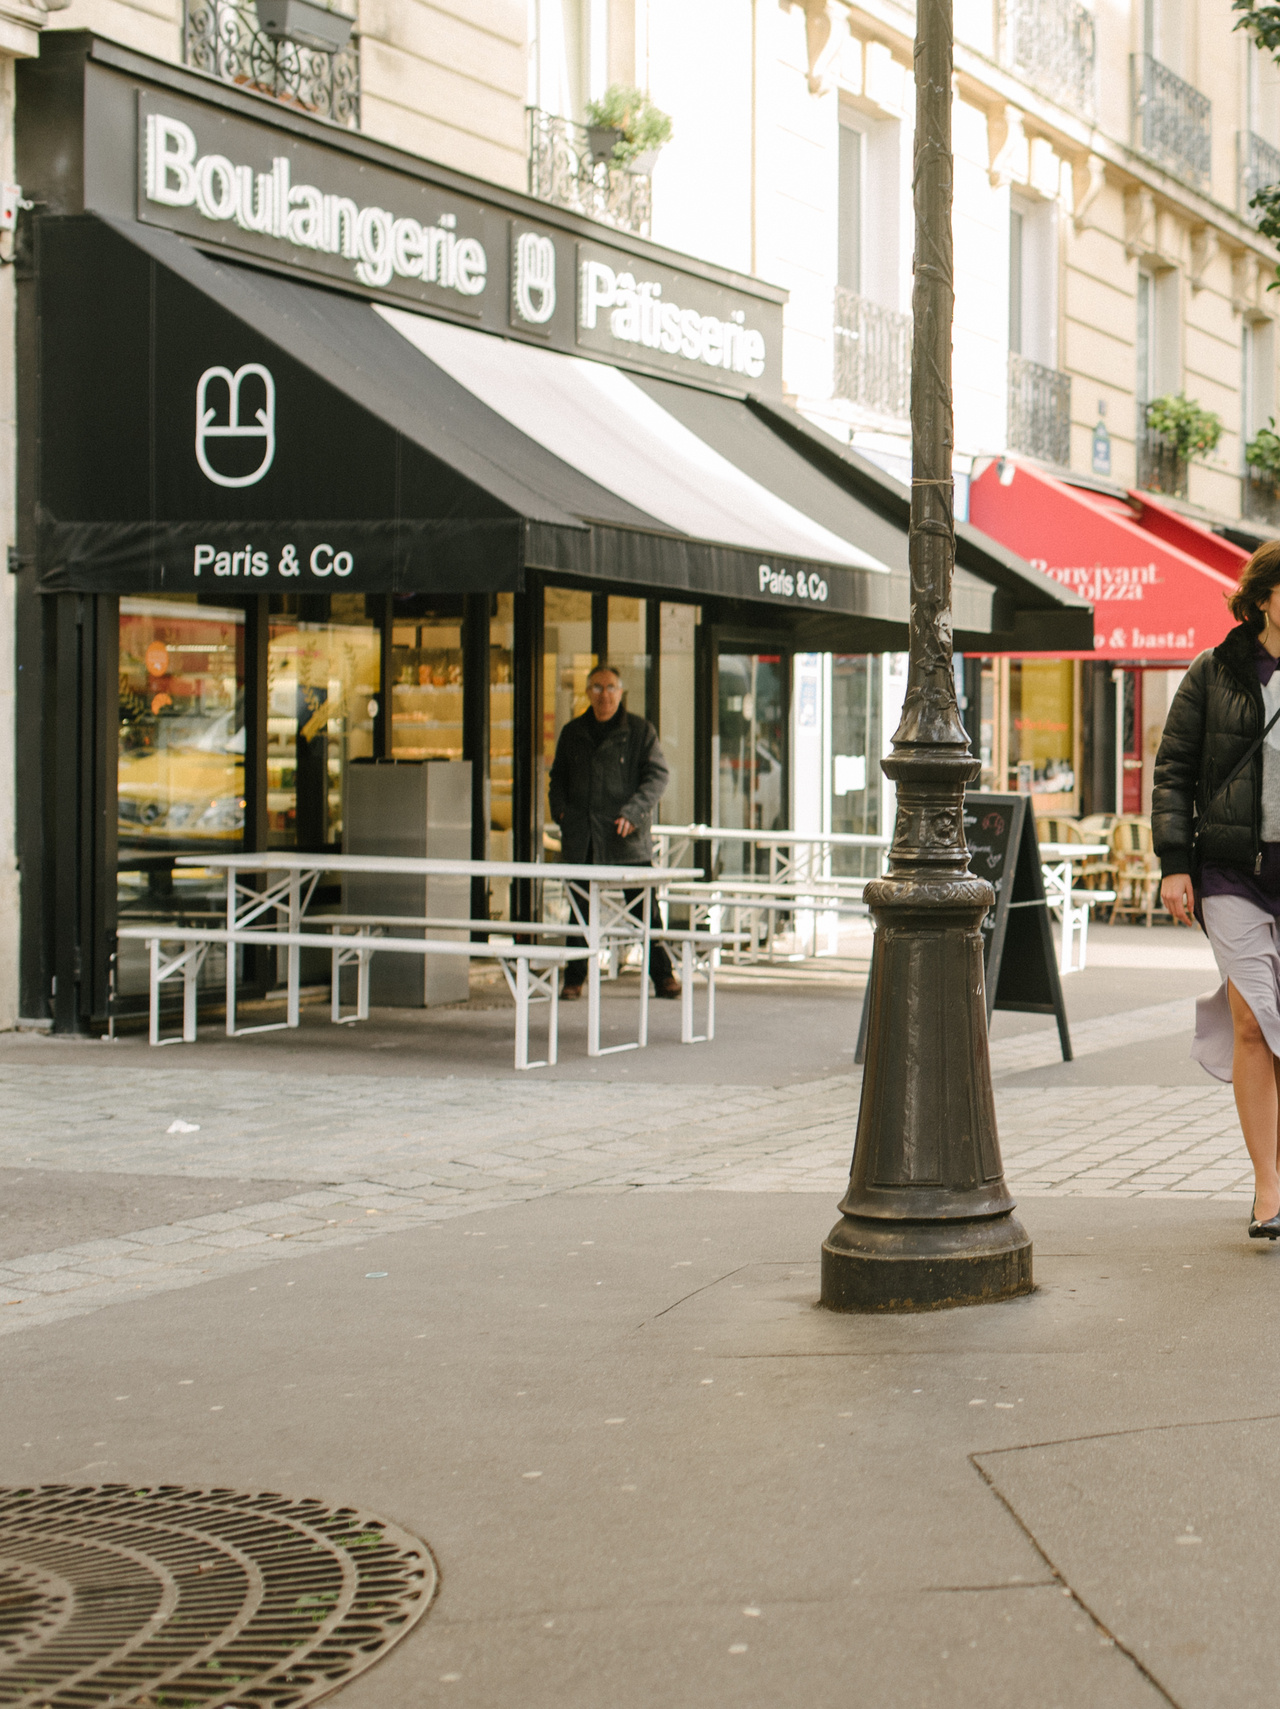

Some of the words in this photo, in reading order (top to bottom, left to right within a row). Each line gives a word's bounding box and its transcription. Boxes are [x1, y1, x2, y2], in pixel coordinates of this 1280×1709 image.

[145, 112, 487, 296] Boulangerie
[579, 260, 766, 378] Pâtisserie
[193, 543, 269, 577] Paris
[278, 543, 300, 577] &
[309, 543, 354, 577] Co
[758, 564, 795, 597] Paris
[796, 570, 808, 598] &
[807, 572, 828, 602] Co
[1108, 627, 1127, 649] &
[1132, 627, 1195, 649] basta!
